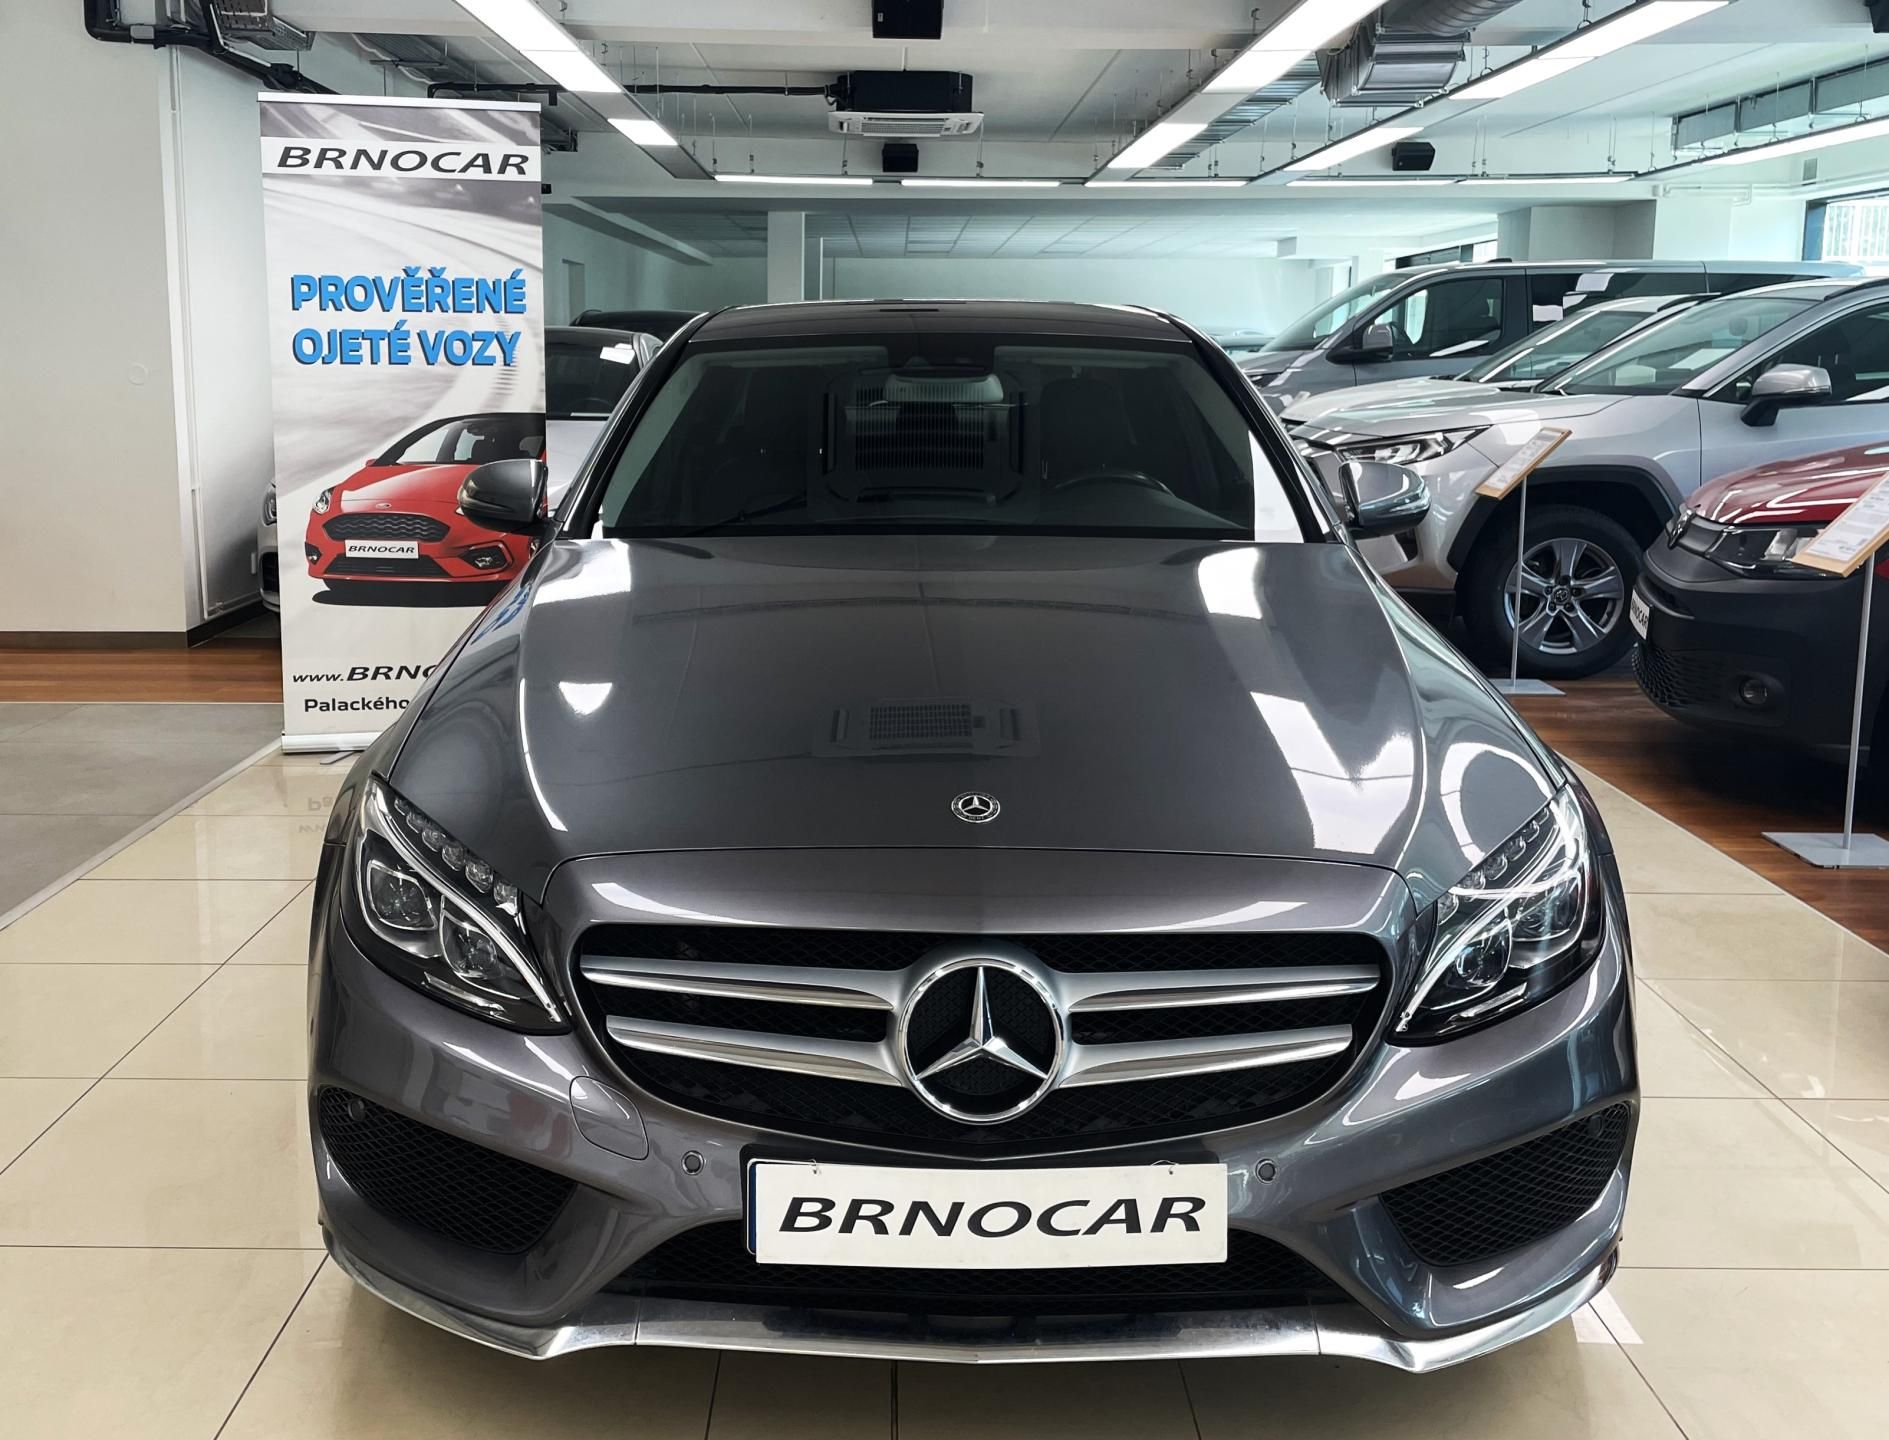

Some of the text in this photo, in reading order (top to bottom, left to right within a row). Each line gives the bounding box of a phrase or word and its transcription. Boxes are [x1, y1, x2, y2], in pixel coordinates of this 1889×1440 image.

[277, 146, 529, 175] BRNOCAR
[291, 266, 527, 314] PROVĚŘENÉ
[293, 320, 521, 366] OJETÉ VOZY
[348, 545, 415, 554] BRNOCAR
[304, 696, 409, 713] Palackého
[779, 1196, 1206, 1238] BRNOCAR
